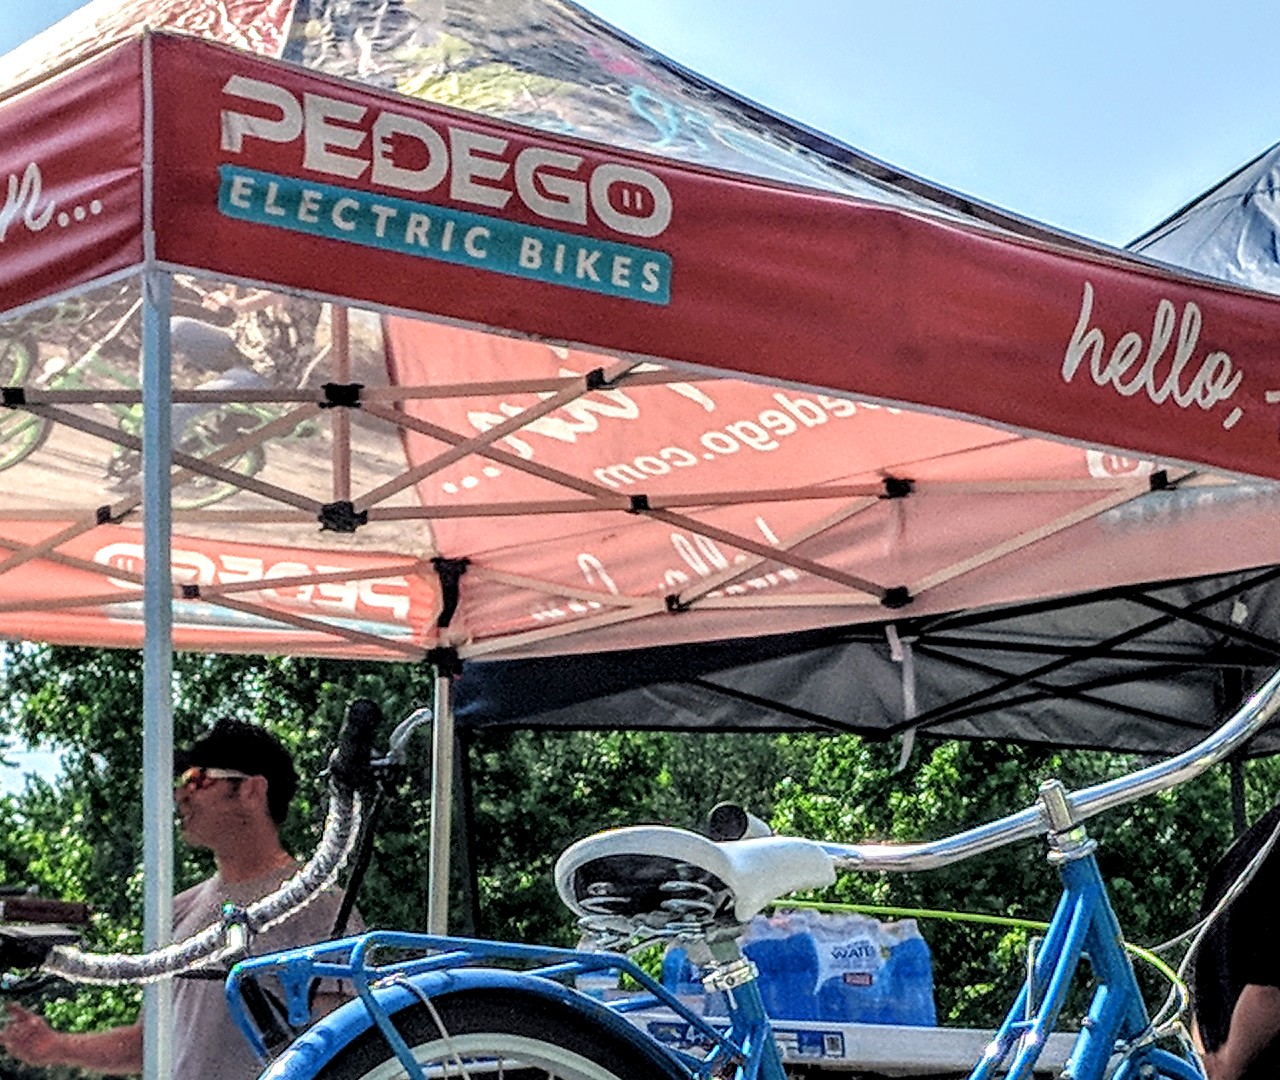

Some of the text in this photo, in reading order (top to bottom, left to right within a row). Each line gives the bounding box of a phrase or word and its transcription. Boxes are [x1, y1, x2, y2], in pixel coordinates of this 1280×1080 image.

[220, 75, 673, 239] PEDEGO
[230, 175, 661, 294] ELECTRIC BIKES
[1062, 281, 1243, 429] hello,
